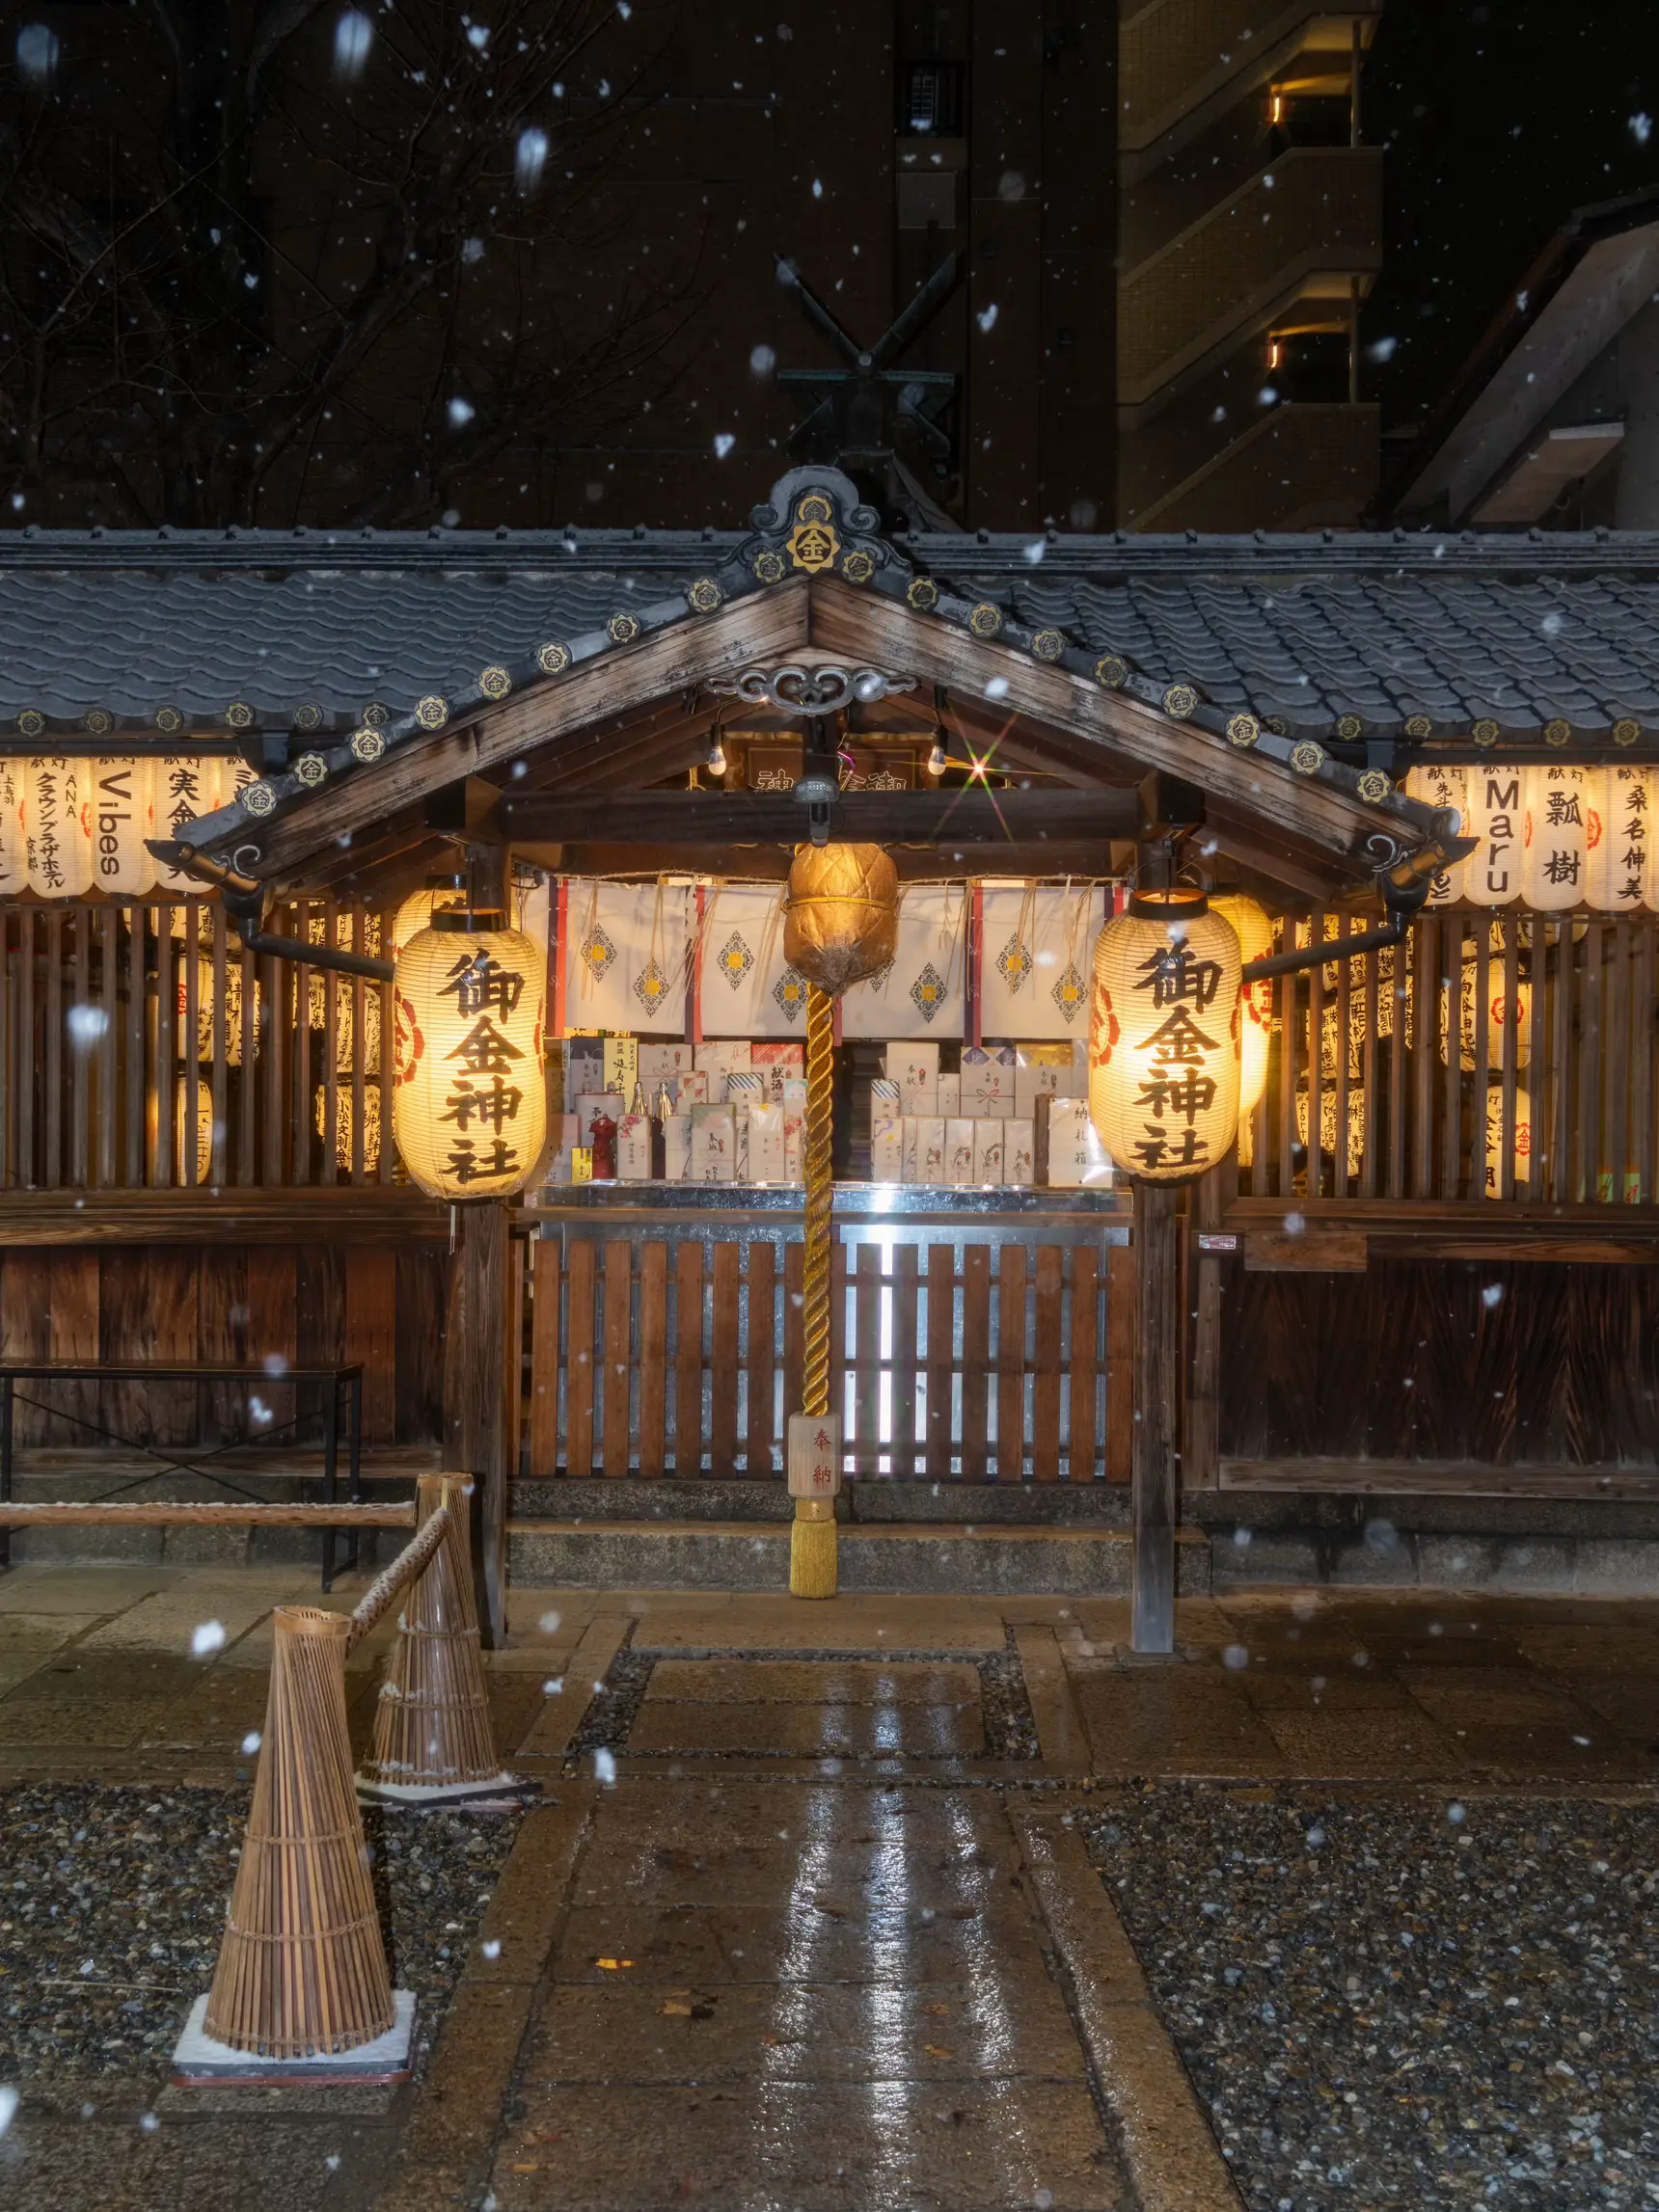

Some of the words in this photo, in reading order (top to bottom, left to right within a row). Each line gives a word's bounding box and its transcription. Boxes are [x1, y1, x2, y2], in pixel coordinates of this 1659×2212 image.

[797, 529, 830, 561] 金
[65, 774, 77, 819] ANA
[98, 770, 132, 876] Vibes
[1547, 767, 1584, 784] 献灯
[37, 771, 67, 889] クラウンプラザホテル
[1486, 779, 1520, 893] Maru
[1542, 791, 1585, 887] 瓢樹
[1617, 784, 1649, 901] 桑名伸美
[436, 947, 527, 1185] 御金神社
[1128, 935, 1224, 1170] 御金神社
[1074, 1107, 1089, 1166] 納札箱
[813, 1428, 831, 1484] 奉納
